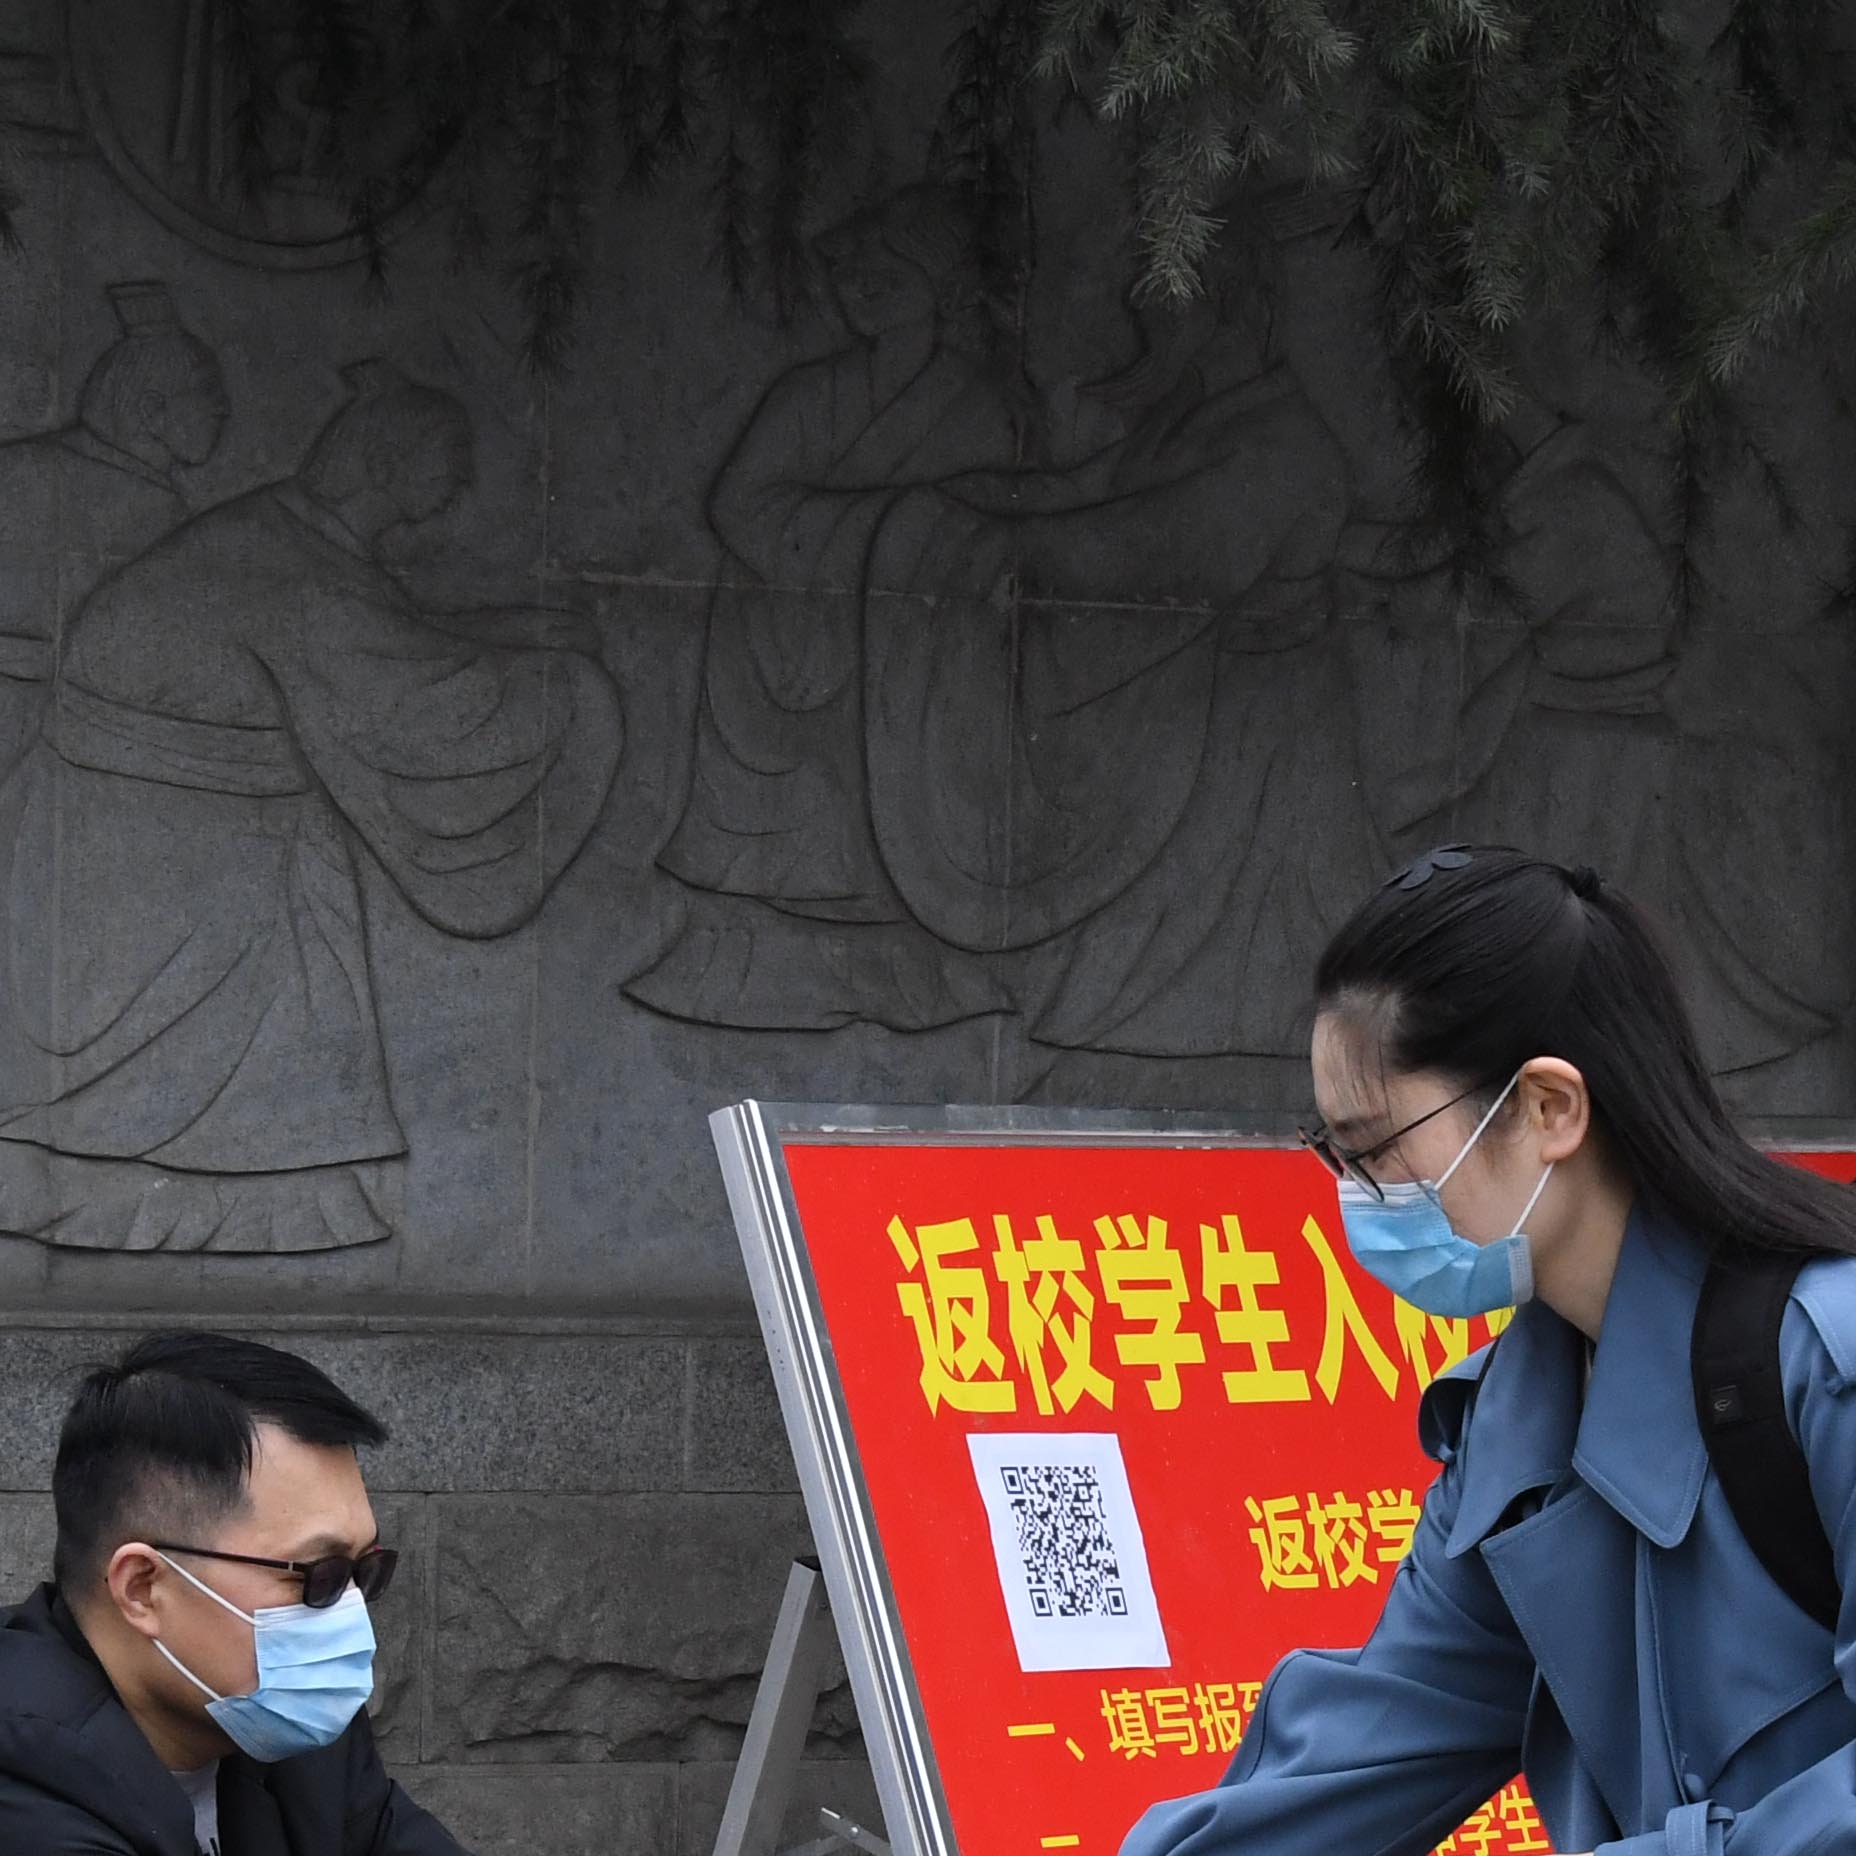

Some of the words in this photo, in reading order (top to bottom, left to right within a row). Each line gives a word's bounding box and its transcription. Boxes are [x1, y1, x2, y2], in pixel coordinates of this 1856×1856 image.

[886, 1213, 1516, 1418] 返校学生入
[1244, 1488, 1422, 1592] 返校学
